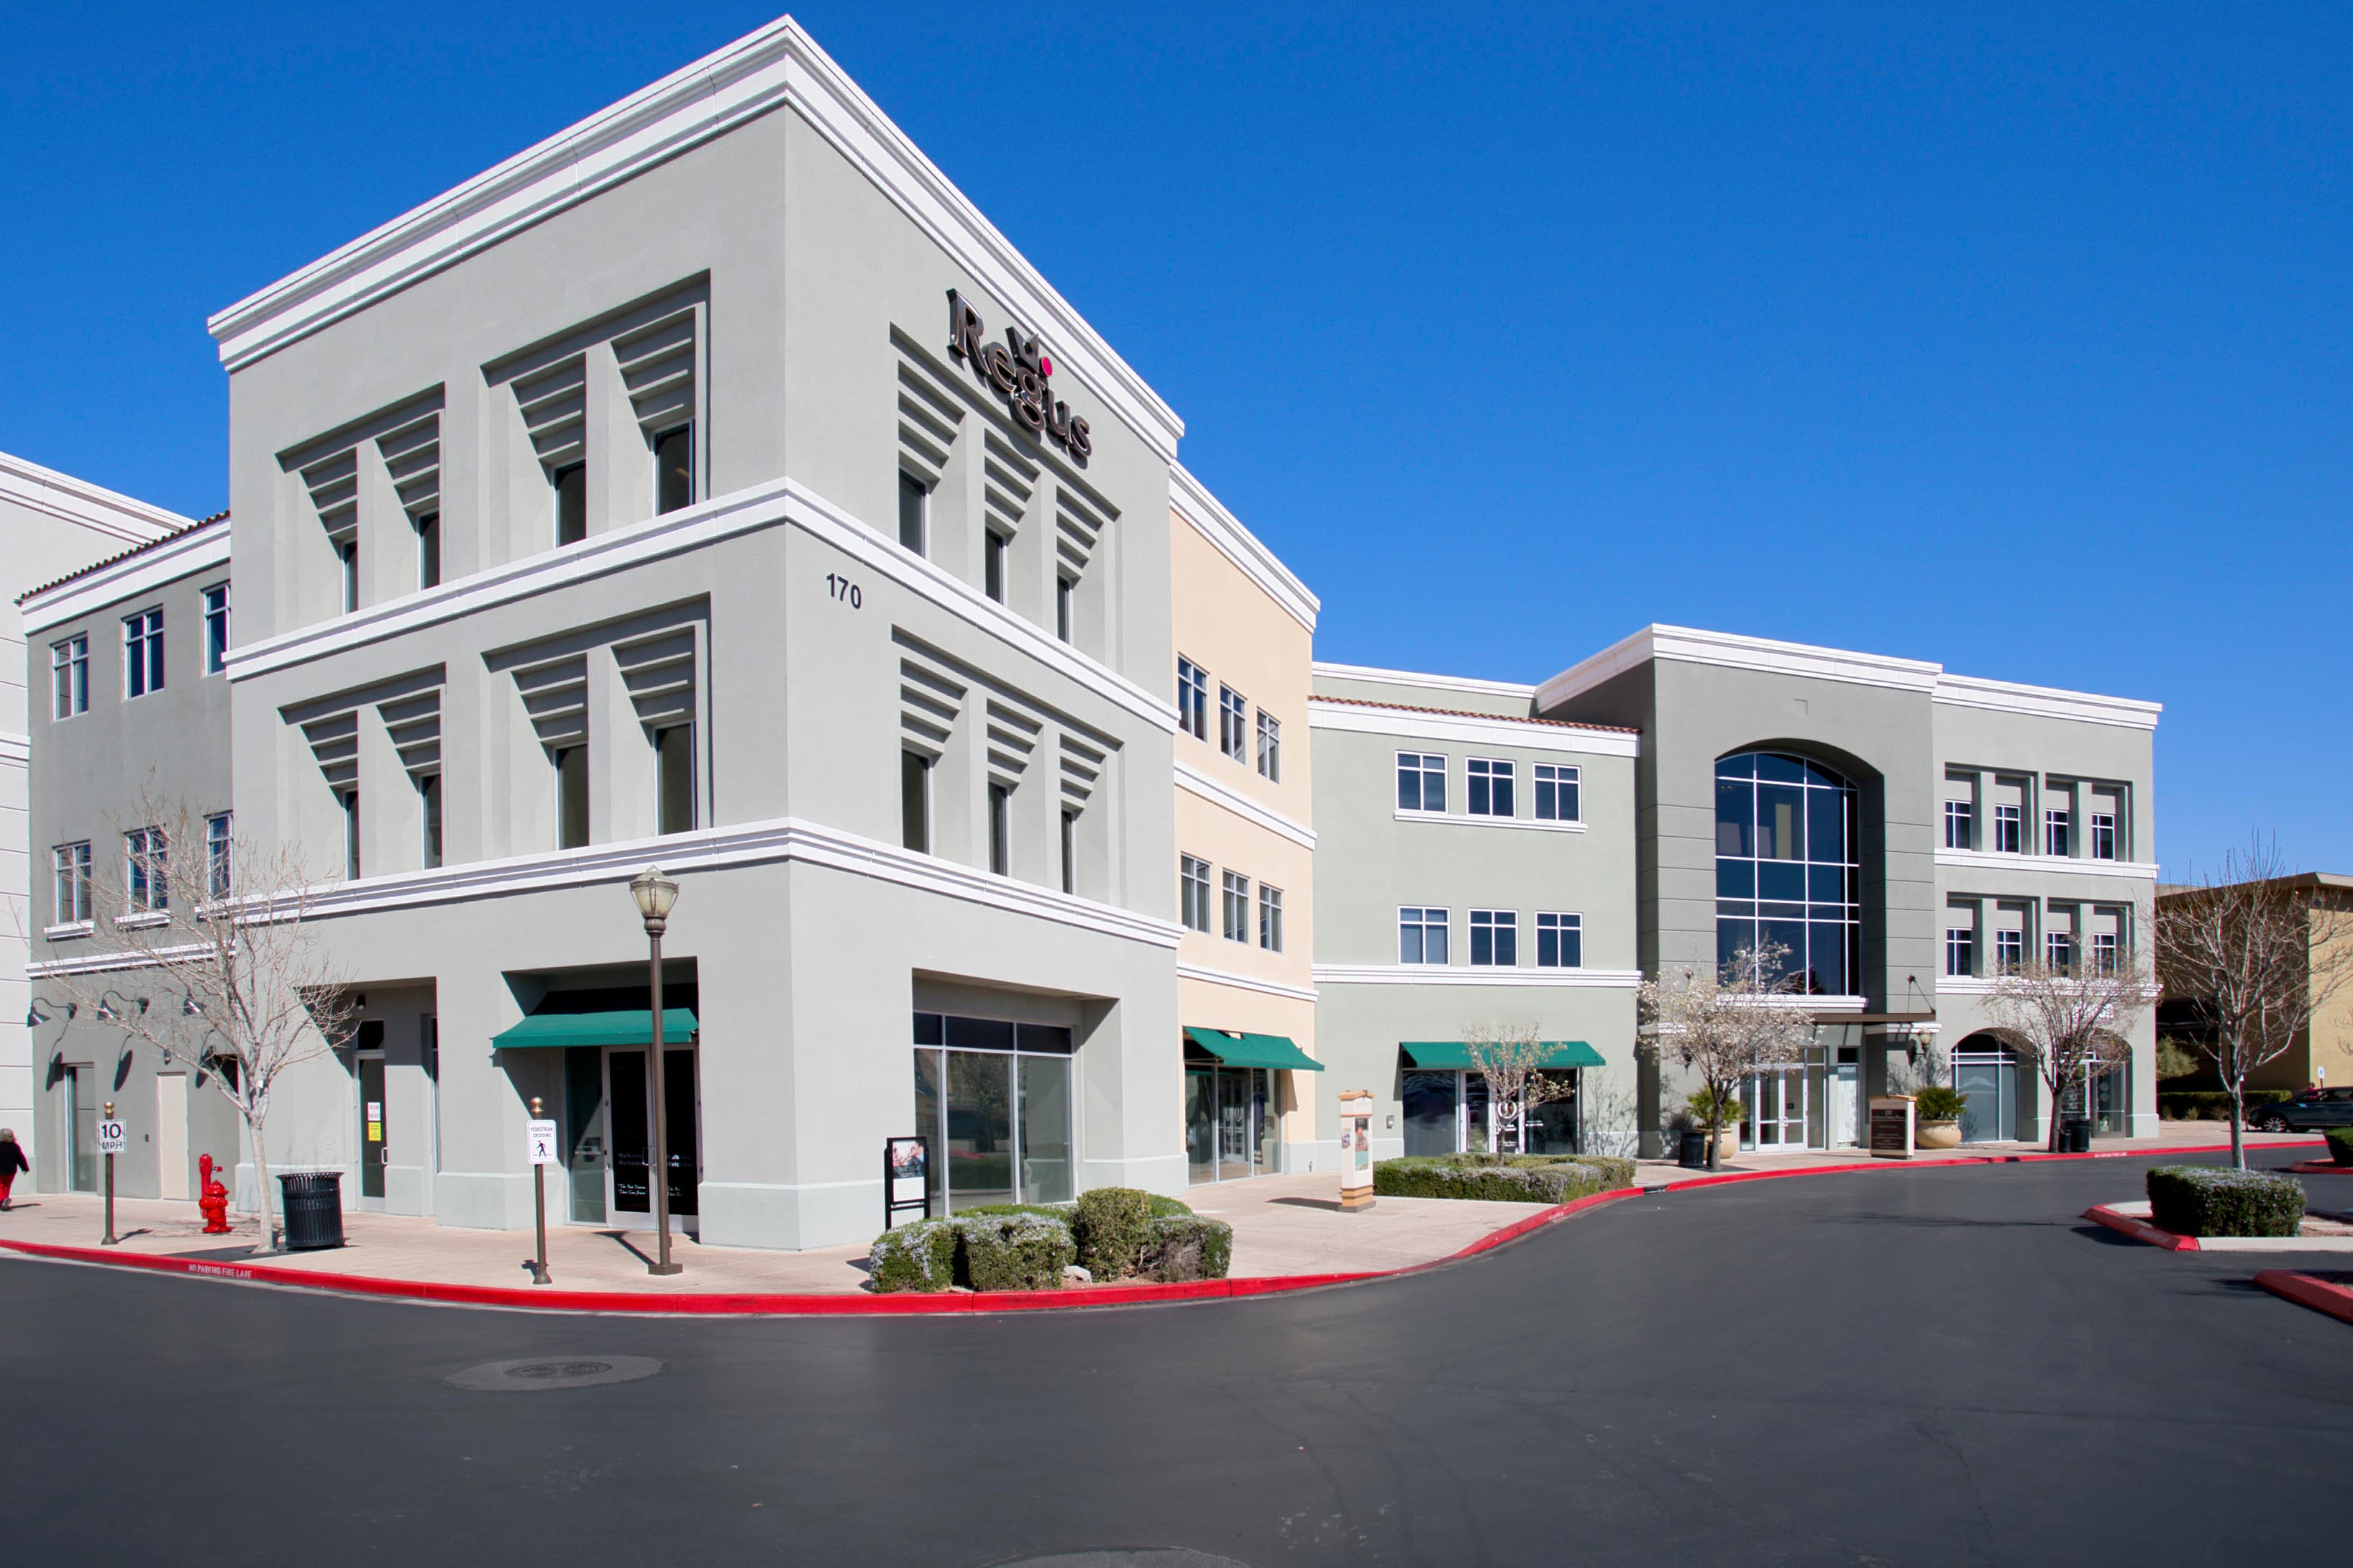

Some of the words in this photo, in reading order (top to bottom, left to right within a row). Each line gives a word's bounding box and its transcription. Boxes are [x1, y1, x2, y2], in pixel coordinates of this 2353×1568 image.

[946, 288, 1092, 458] Regus
[826, 572, 862, 610] 170
[101, 1124, 122, 1139] 10
[102, 1141, 122, 1150] MPH
[197, 1265, 221, 1275] PARKING
[221, 1267, 235, 1277] FIRE
[236, 1269, 252, 1279] LANE
